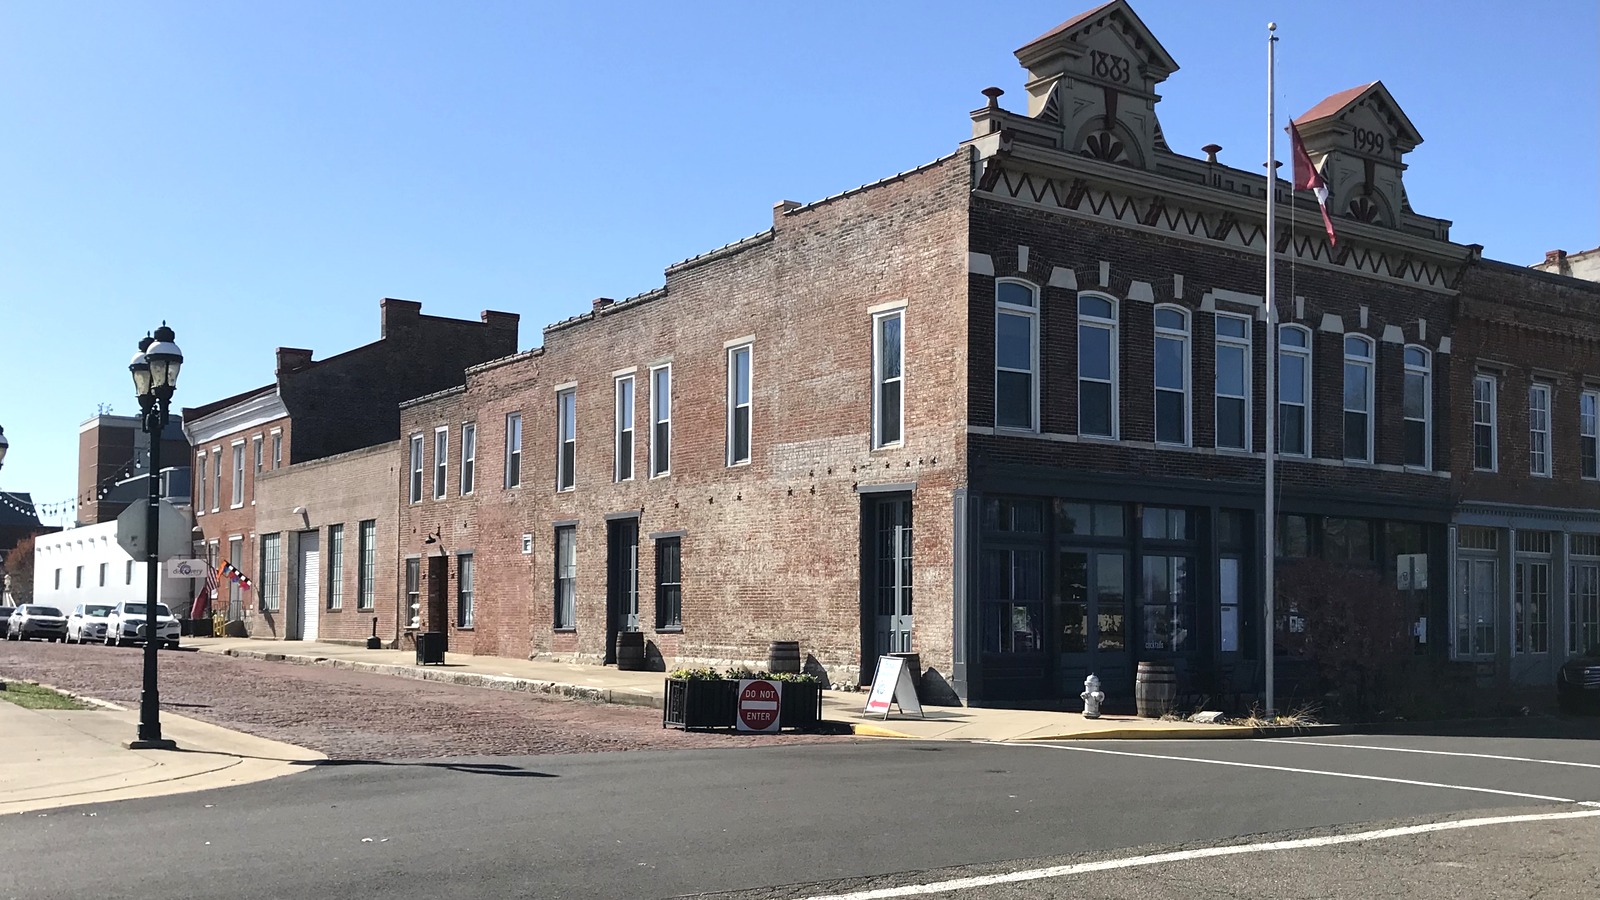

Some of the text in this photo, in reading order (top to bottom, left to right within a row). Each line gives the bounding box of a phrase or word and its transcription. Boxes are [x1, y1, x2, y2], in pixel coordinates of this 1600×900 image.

[1090, 50, 1130, 84] 1883
[1352, 126, 1384, 153] 1999
[745, 690, 776, 698] DO NOT
[746, 712, 771, 720] ENTER
